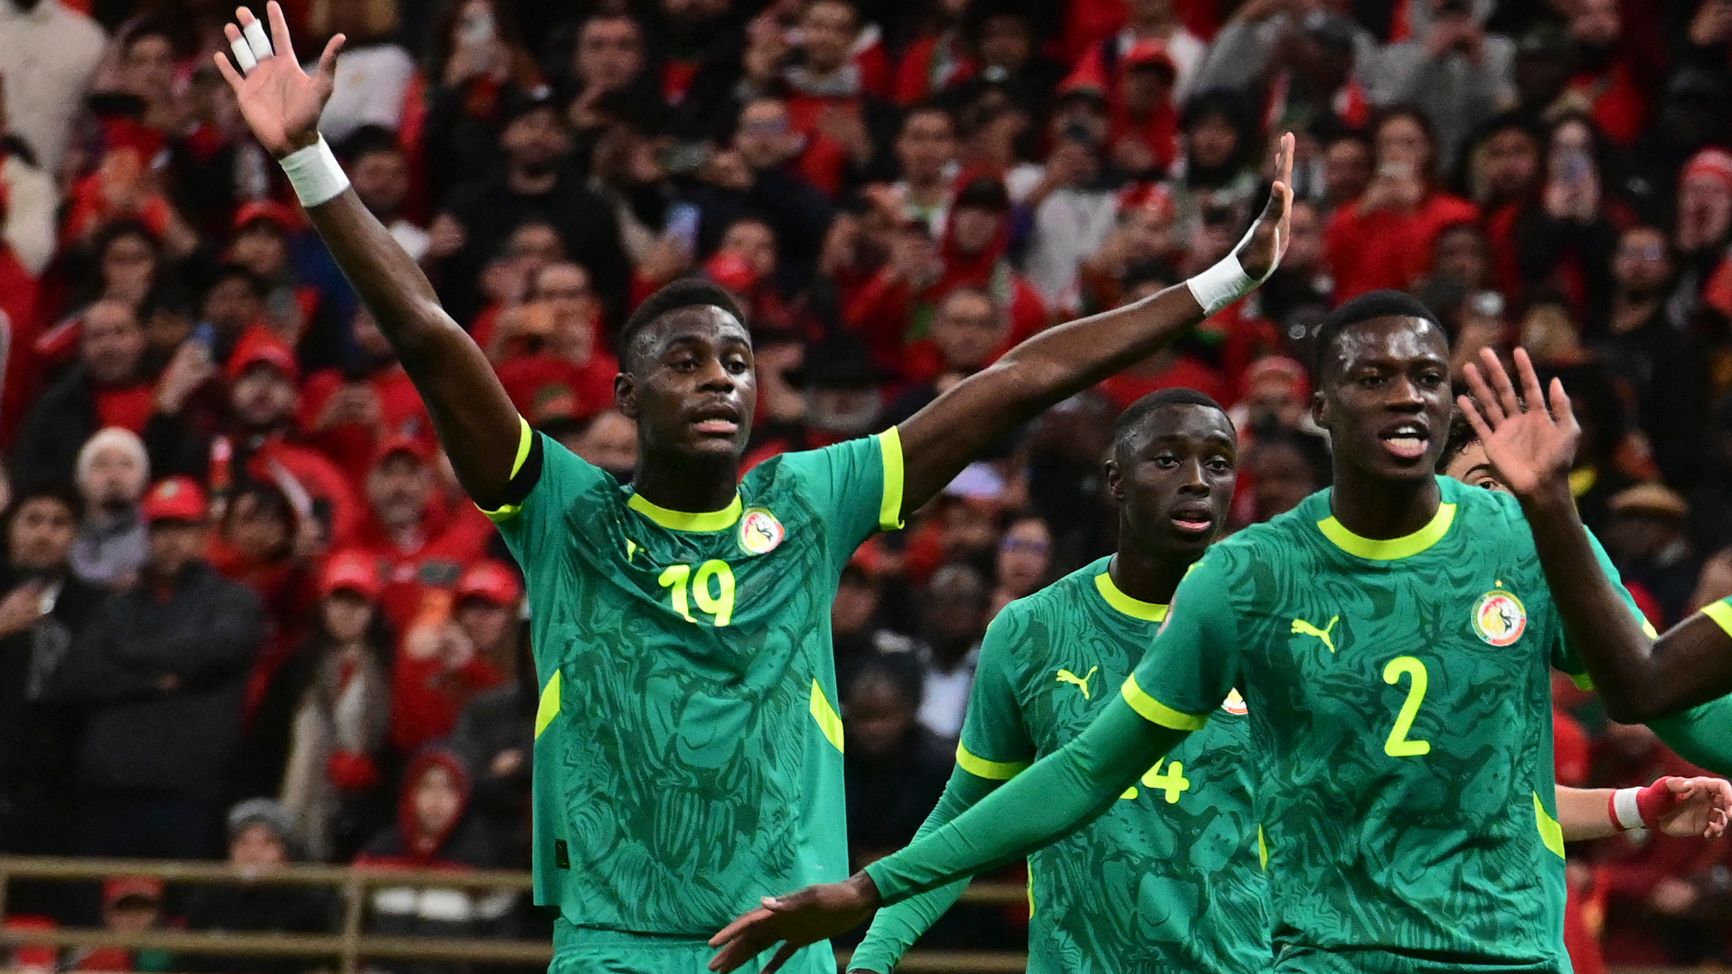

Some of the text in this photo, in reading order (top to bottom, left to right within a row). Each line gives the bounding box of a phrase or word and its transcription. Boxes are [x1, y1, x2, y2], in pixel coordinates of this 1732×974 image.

[658, 559, 736, 627] 19
[1383, 656, 1431, 757] 2
[1120, 756, 1190, 804] 4
